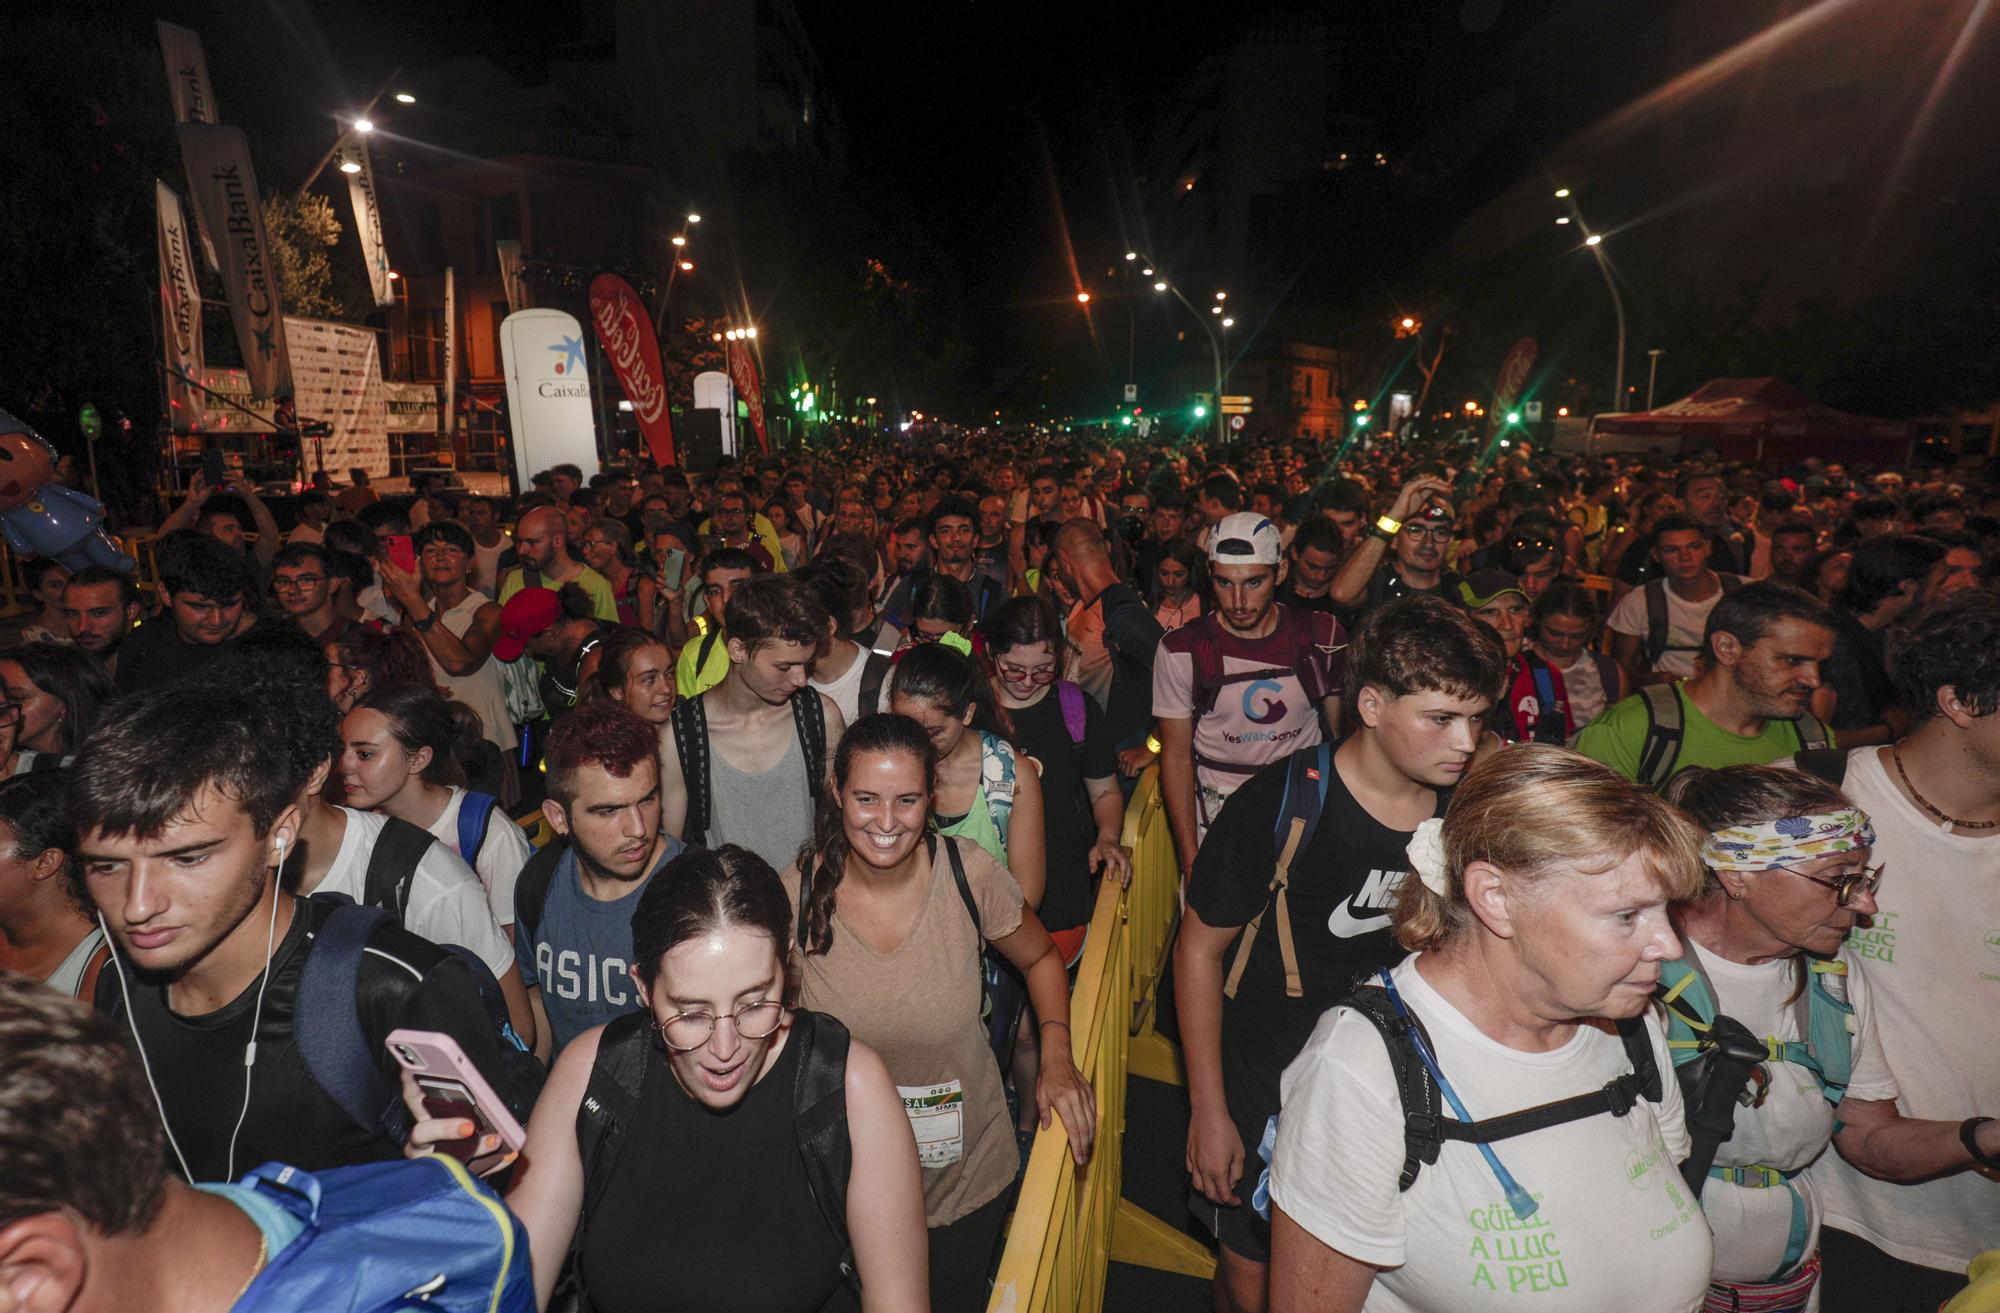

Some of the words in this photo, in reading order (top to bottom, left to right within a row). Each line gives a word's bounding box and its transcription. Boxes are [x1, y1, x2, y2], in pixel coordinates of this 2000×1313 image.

[178, 64, 206, 124] Bank
[213, 164, 272, 318] CaixaBank
[167, 224, 192, 356] CaixaBank
[538, 382, 590, 398] CaixaB
[1352, 868, 1408, 909] NI
[1852, 928, 1896, 948] LUC
[536, 941, 645, 1009] ASIC
[903, 1097, 928, 1109] SAL
[1470, 1236, 1491, 1260] A
[1495, 1232, 1561, 1261] LLUC
[1471, 1263, 1498, 1292] A
[1506, 1260, 1569, 1293] PEU
